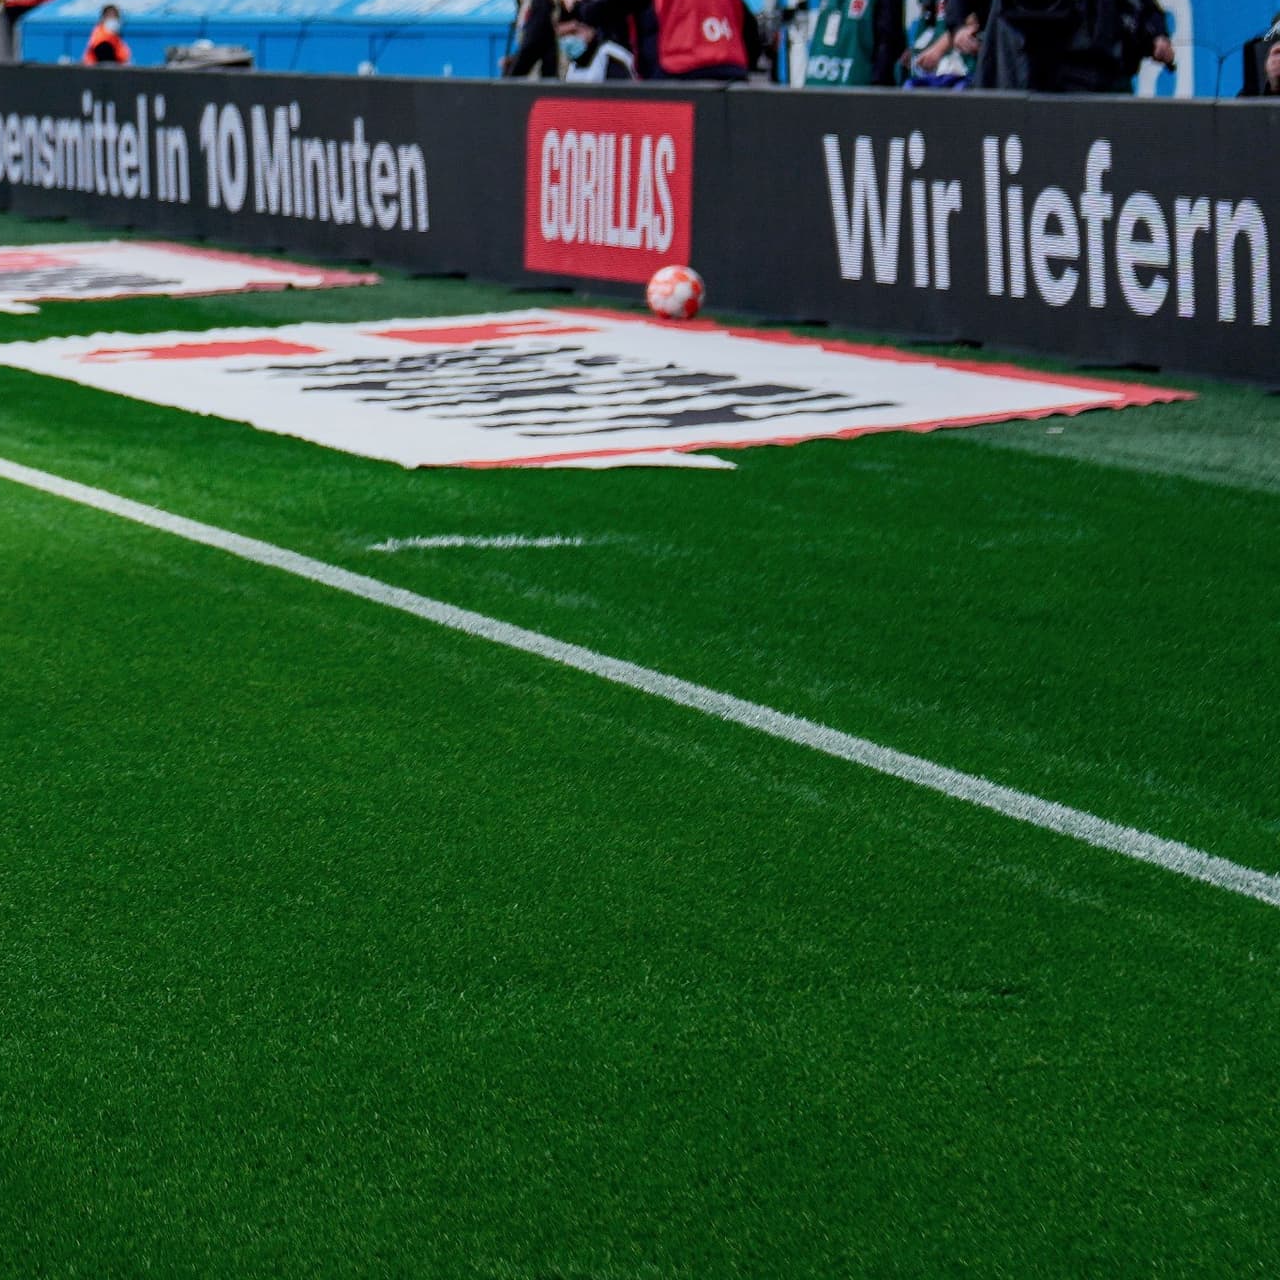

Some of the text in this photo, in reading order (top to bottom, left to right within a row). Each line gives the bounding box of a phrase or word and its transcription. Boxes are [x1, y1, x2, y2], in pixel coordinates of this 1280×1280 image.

[153, 93, 190, 205] in
[199, 101, 248, 213] 10
[250, 100, 430, 233] Minuten
[541, 128, 677, 254] GORILLAS
[822, 130, 1272, 327] Wir liefern
